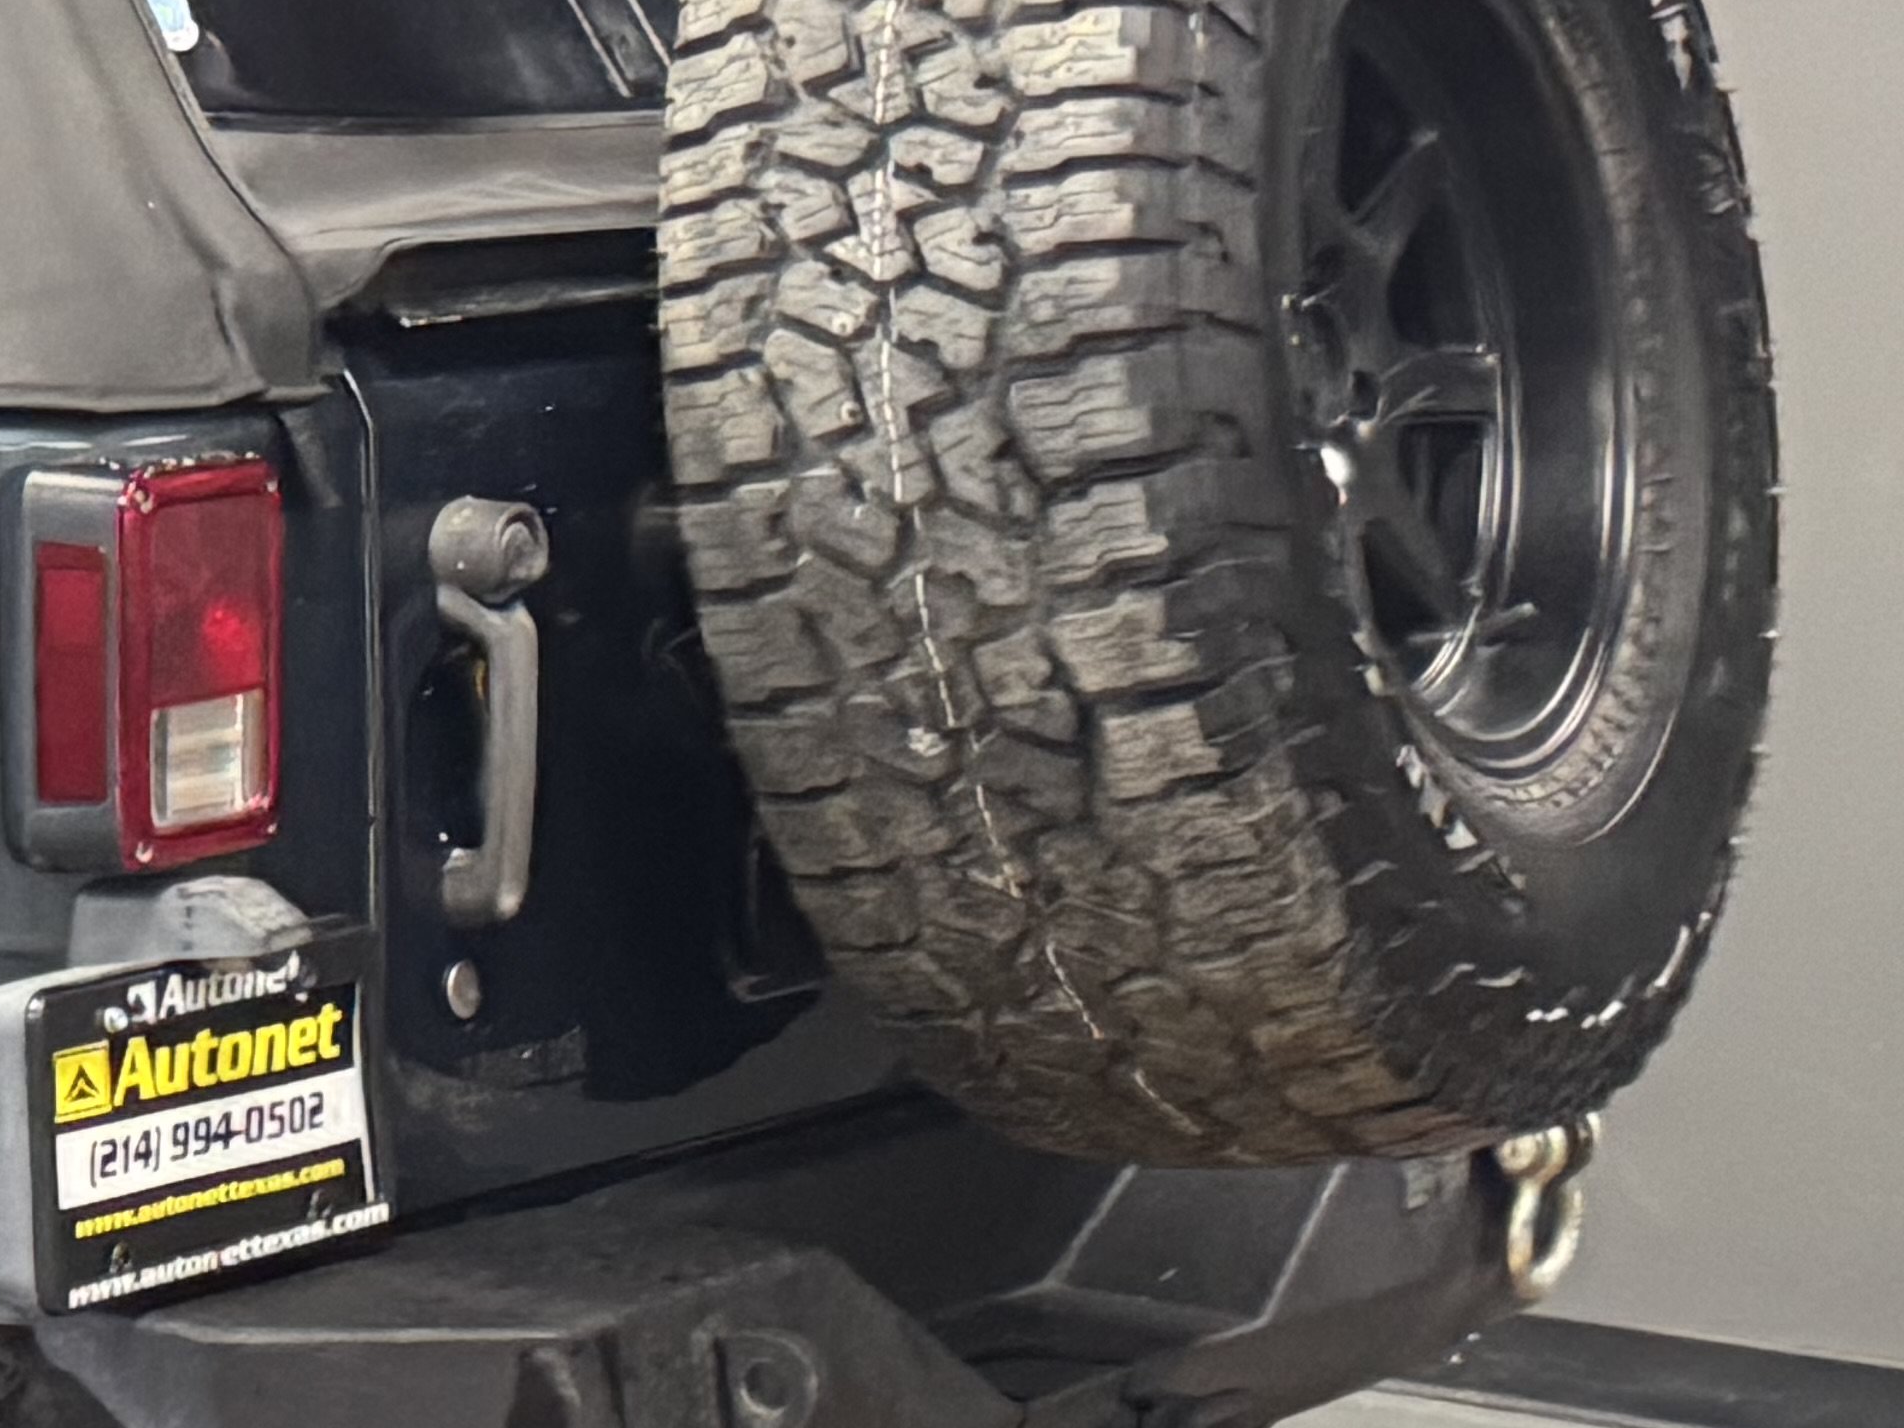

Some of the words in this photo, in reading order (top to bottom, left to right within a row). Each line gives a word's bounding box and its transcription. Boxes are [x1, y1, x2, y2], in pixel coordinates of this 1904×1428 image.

[113, 1003, 343, 1107] Autonet
[89, 1126, 162, 1188] (214)
[170, 1091, 325, 1162] 994-0502
[74, 1158, 346, 1239] www.autonettexas.com
[67, 1202, 390, 1309] www.autonettexas.com
